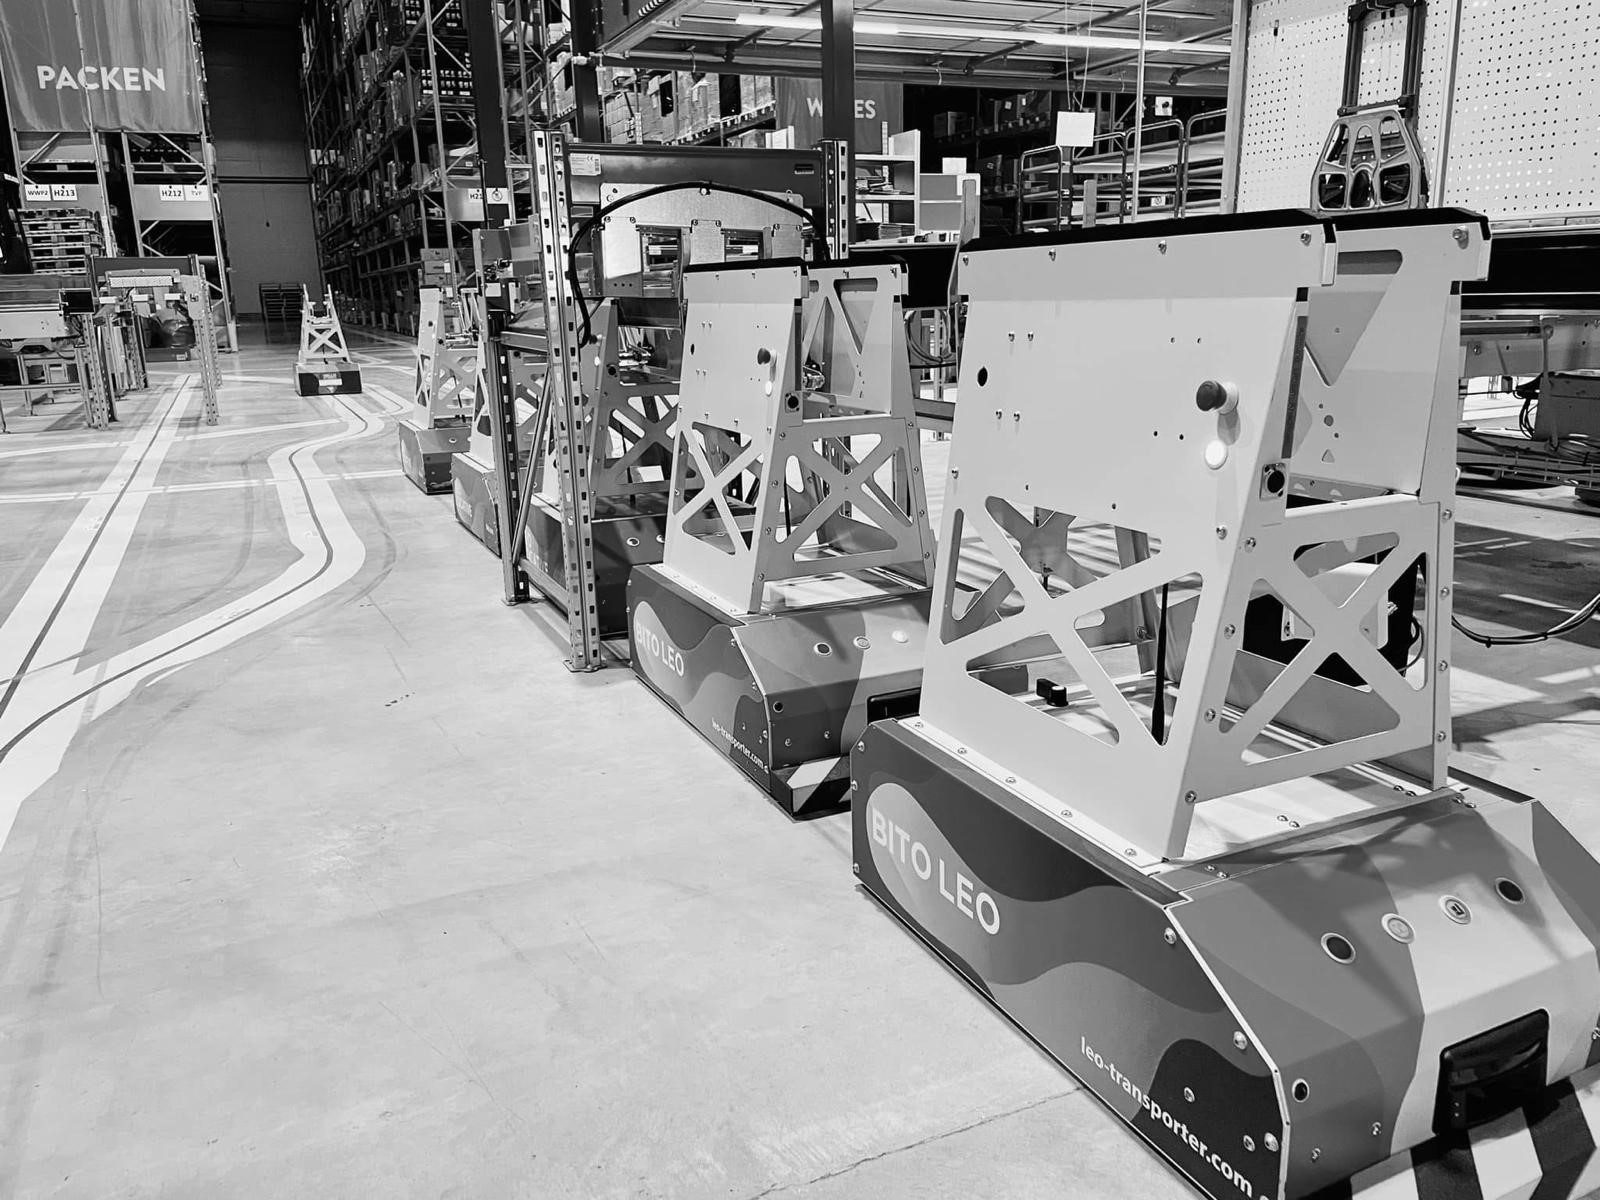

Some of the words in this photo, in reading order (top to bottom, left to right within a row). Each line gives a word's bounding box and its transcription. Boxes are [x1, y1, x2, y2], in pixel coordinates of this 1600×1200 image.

[36, 65, 166, 91] PACKEN
[53, 189, 76, 197] H213
[636, 621, 660, 657] BITO
[661, 640, 684, 677] LEO
[872, 807, 931, 881] BITO
[939, 858, 1000, 935] LEO
[1080, 1036, 1253, 1198] leo-transporter.com
